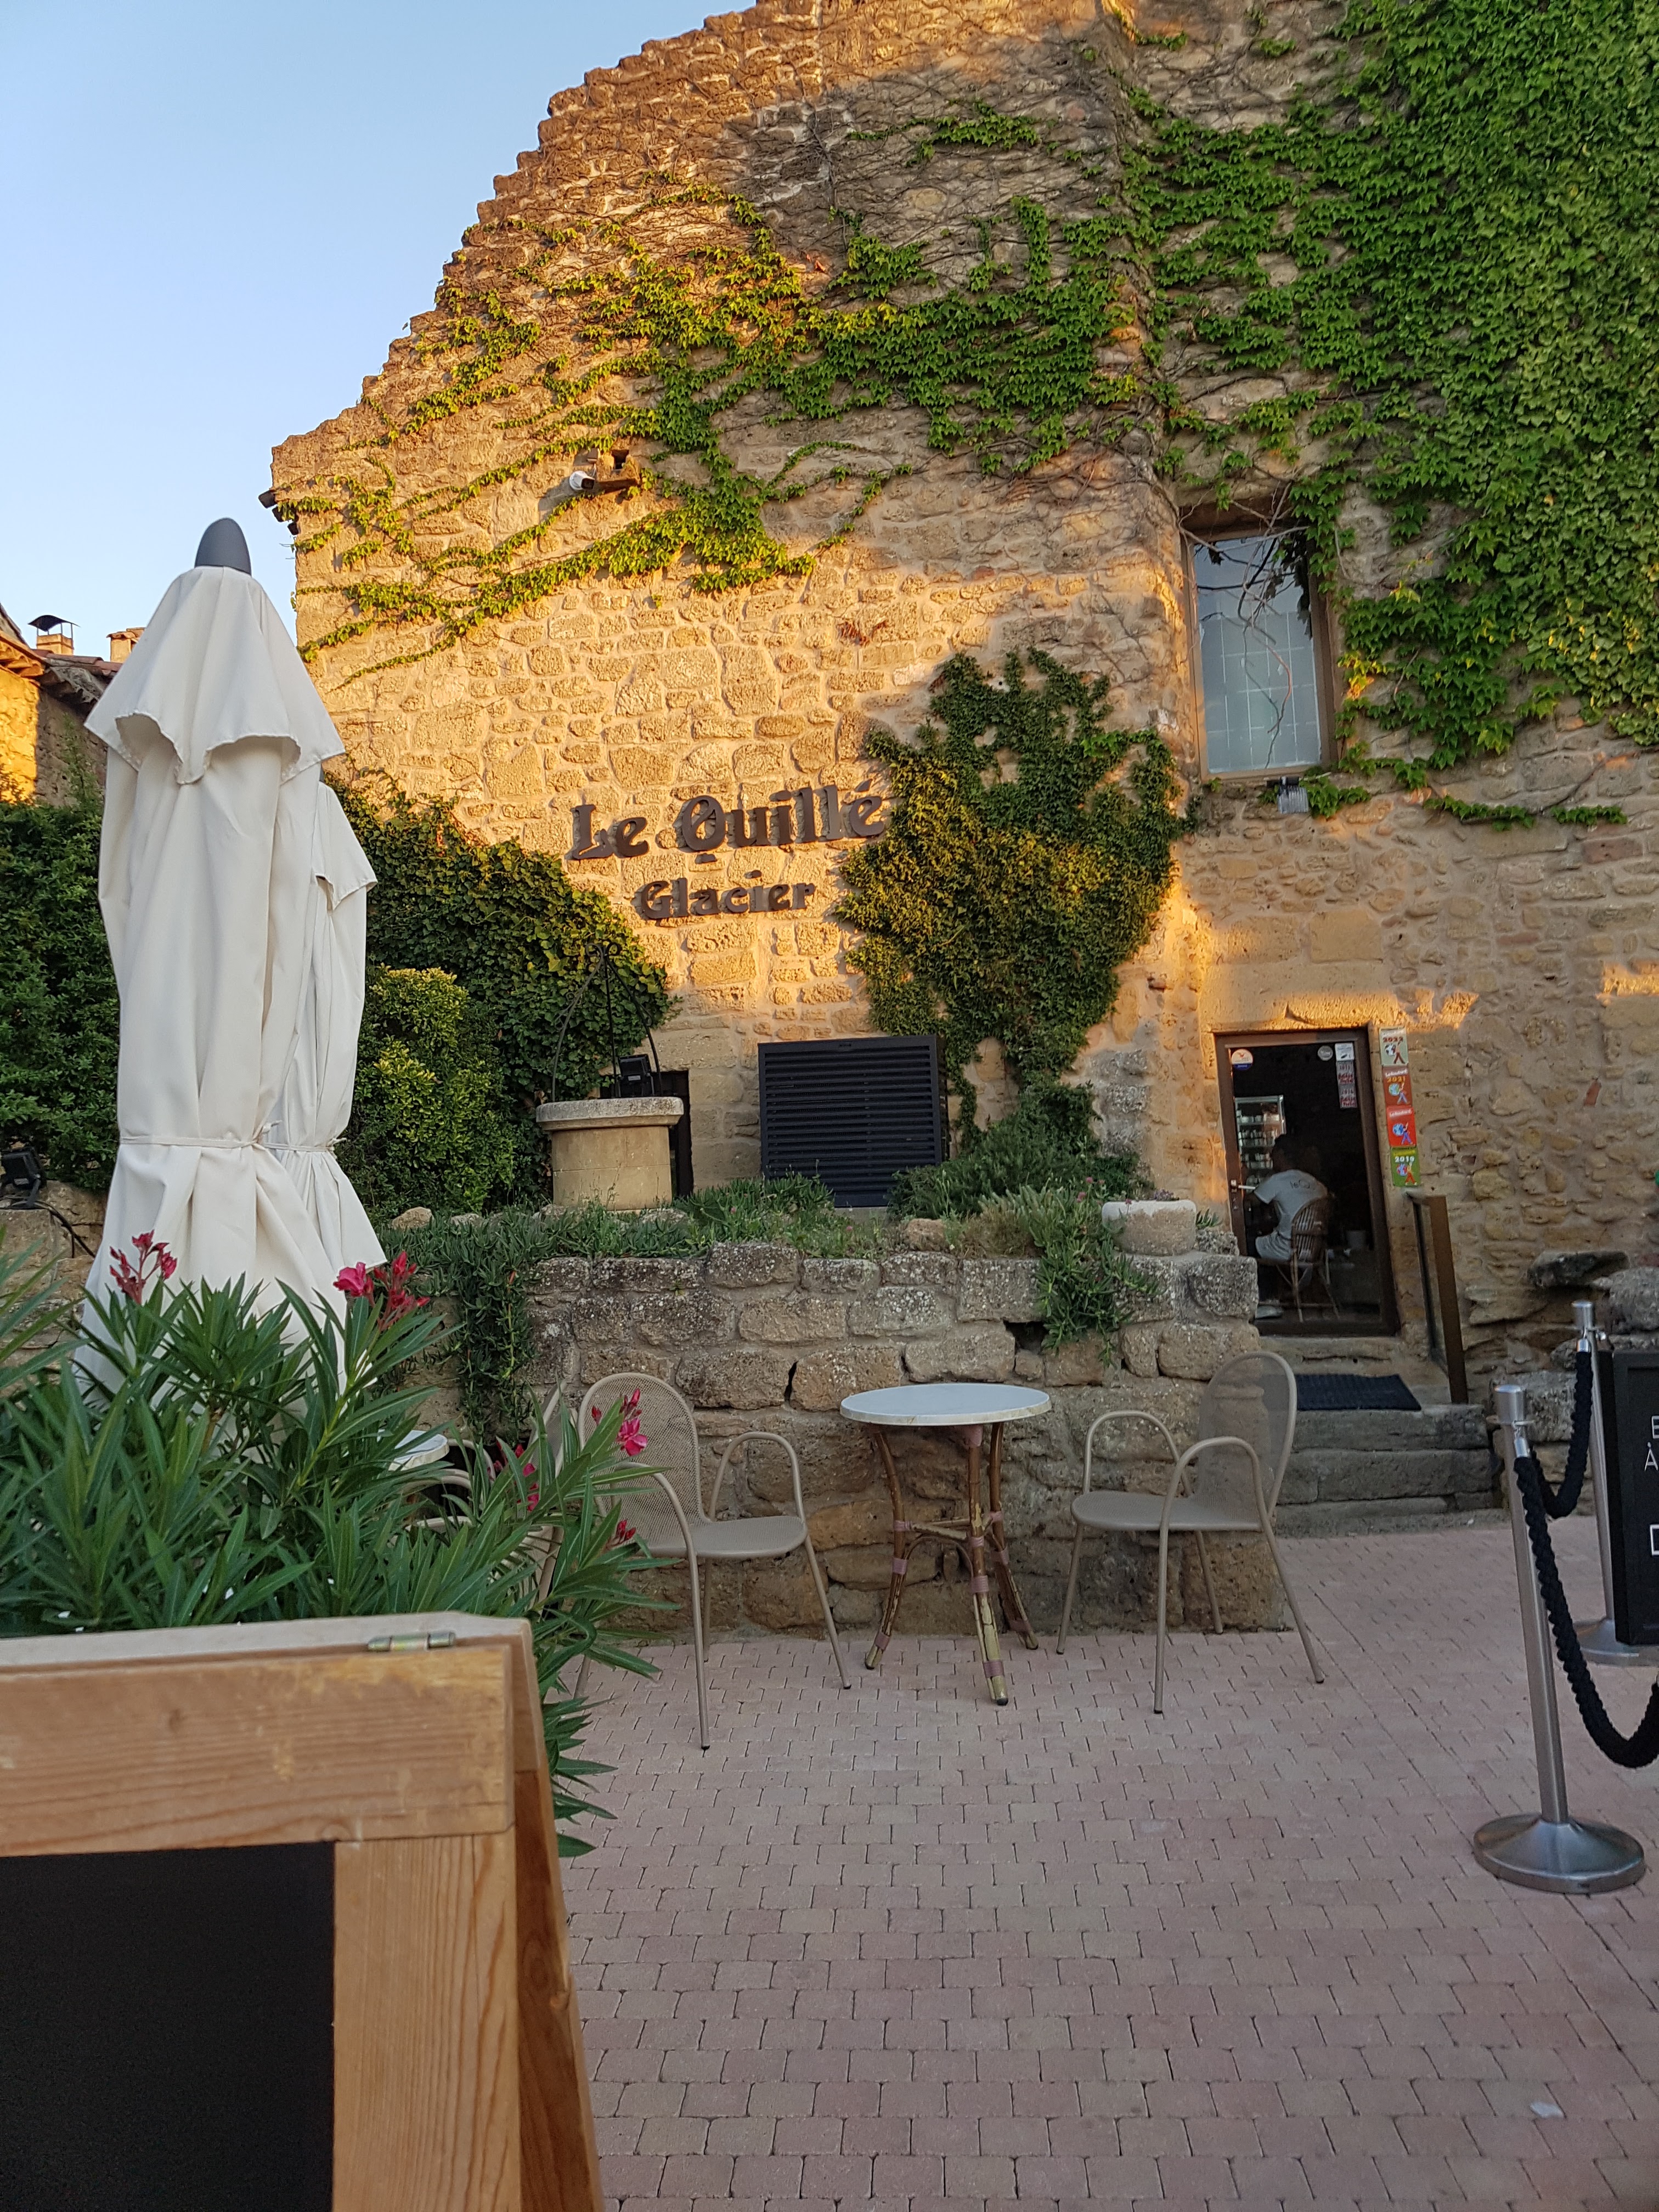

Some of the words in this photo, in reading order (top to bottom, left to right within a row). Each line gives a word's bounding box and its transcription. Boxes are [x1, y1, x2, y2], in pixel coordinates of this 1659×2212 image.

[571, 804, 650, 860] Le
[682, 779, 885, 863] Quillé
[641, 870, 816, 919] Glacier
